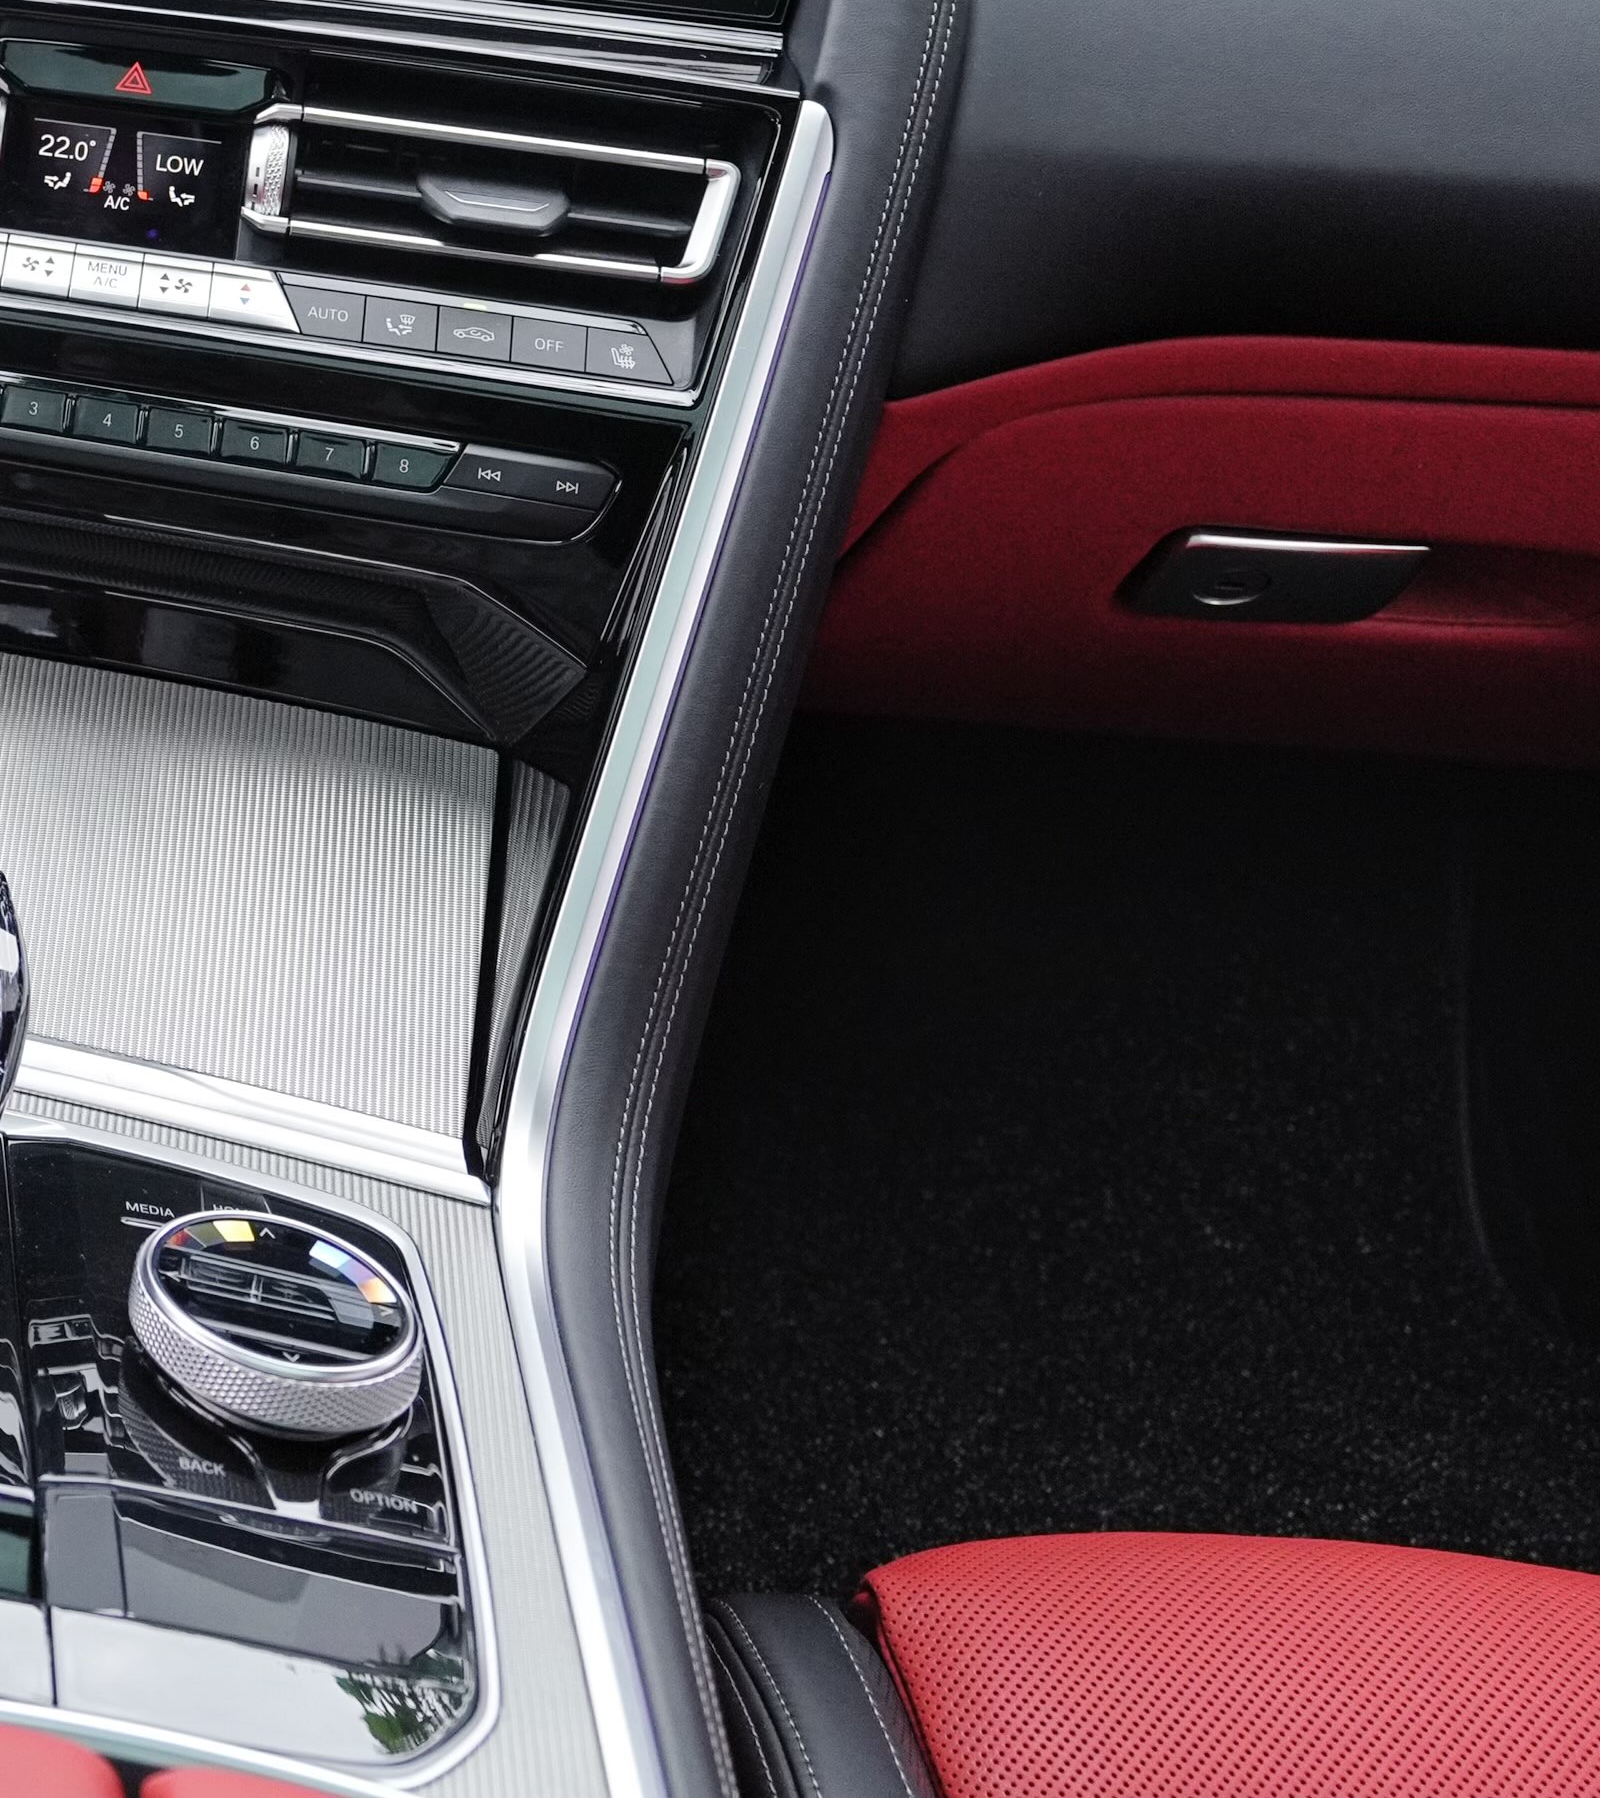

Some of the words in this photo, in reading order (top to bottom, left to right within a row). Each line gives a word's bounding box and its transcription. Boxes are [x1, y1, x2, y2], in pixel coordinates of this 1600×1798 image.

[155, 154, 205, 177] LOW
[104, 194, 131, 211] A/C
[87, 260, 128, 277] MENU
[93, 274, 118, 289] A/C
[307, 306, 349, 323] AUTO
[534, 337, 564, 353] OFF
[29, 401, 38, 416] 3
[103, 413, 112, 428] 4
[175, 423, 184, 439] 5
[250, 435, 260, 451] 6
[325, 447, 334, 462] 7
[399, 458, 410, 473] 8
[125, 1201, 175, 1218] MEDIA
[178, 1455, 226, 1477] BACK
[350, 1488, 418, 1514] OPTION
